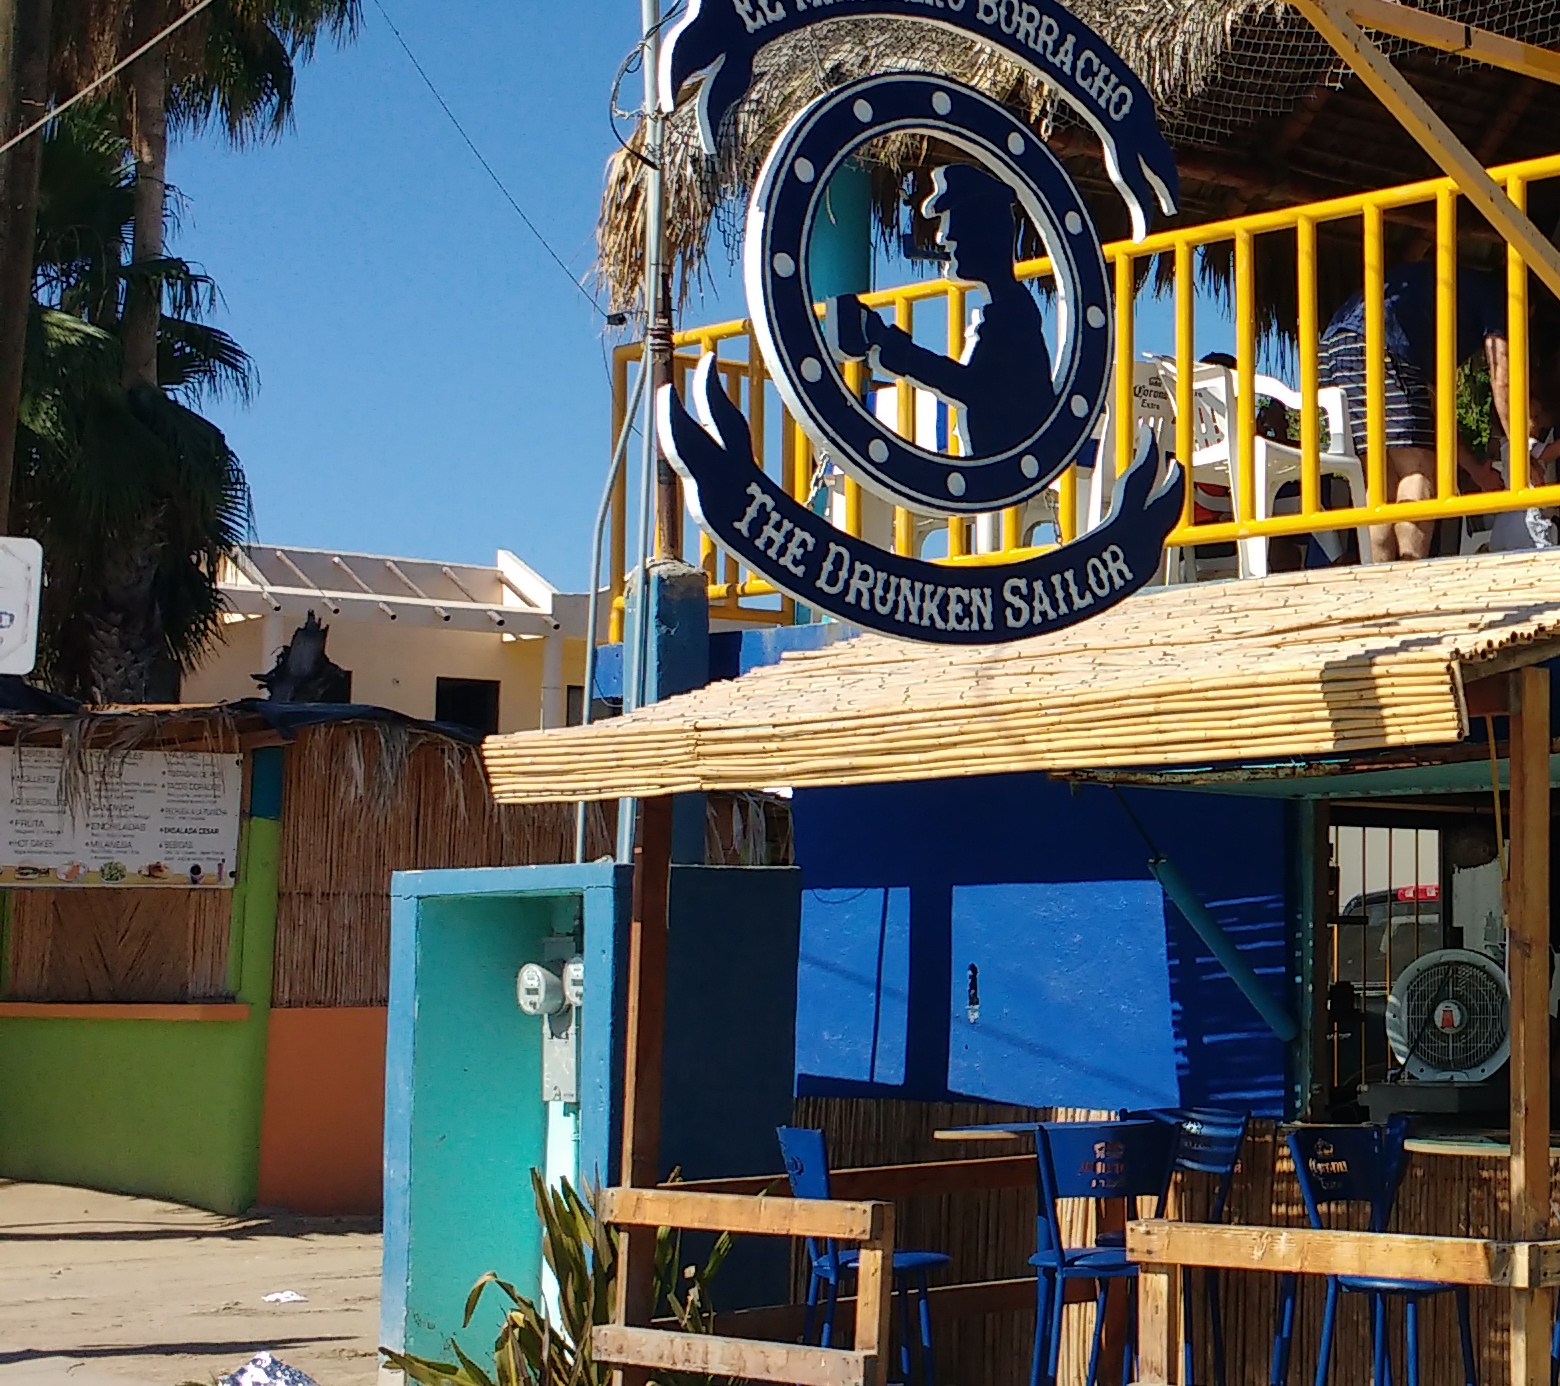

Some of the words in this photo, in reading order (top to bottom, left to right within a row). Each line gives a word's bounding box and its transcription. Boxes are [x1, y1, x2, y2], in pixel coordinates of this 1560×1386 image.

[1141, 399, 1160, 410] Extra
[733, 481, 817, 579] THE
[815, 541, 994, 632] DRUNKEN
[1002, 543, 1134, 629] SAILOR
